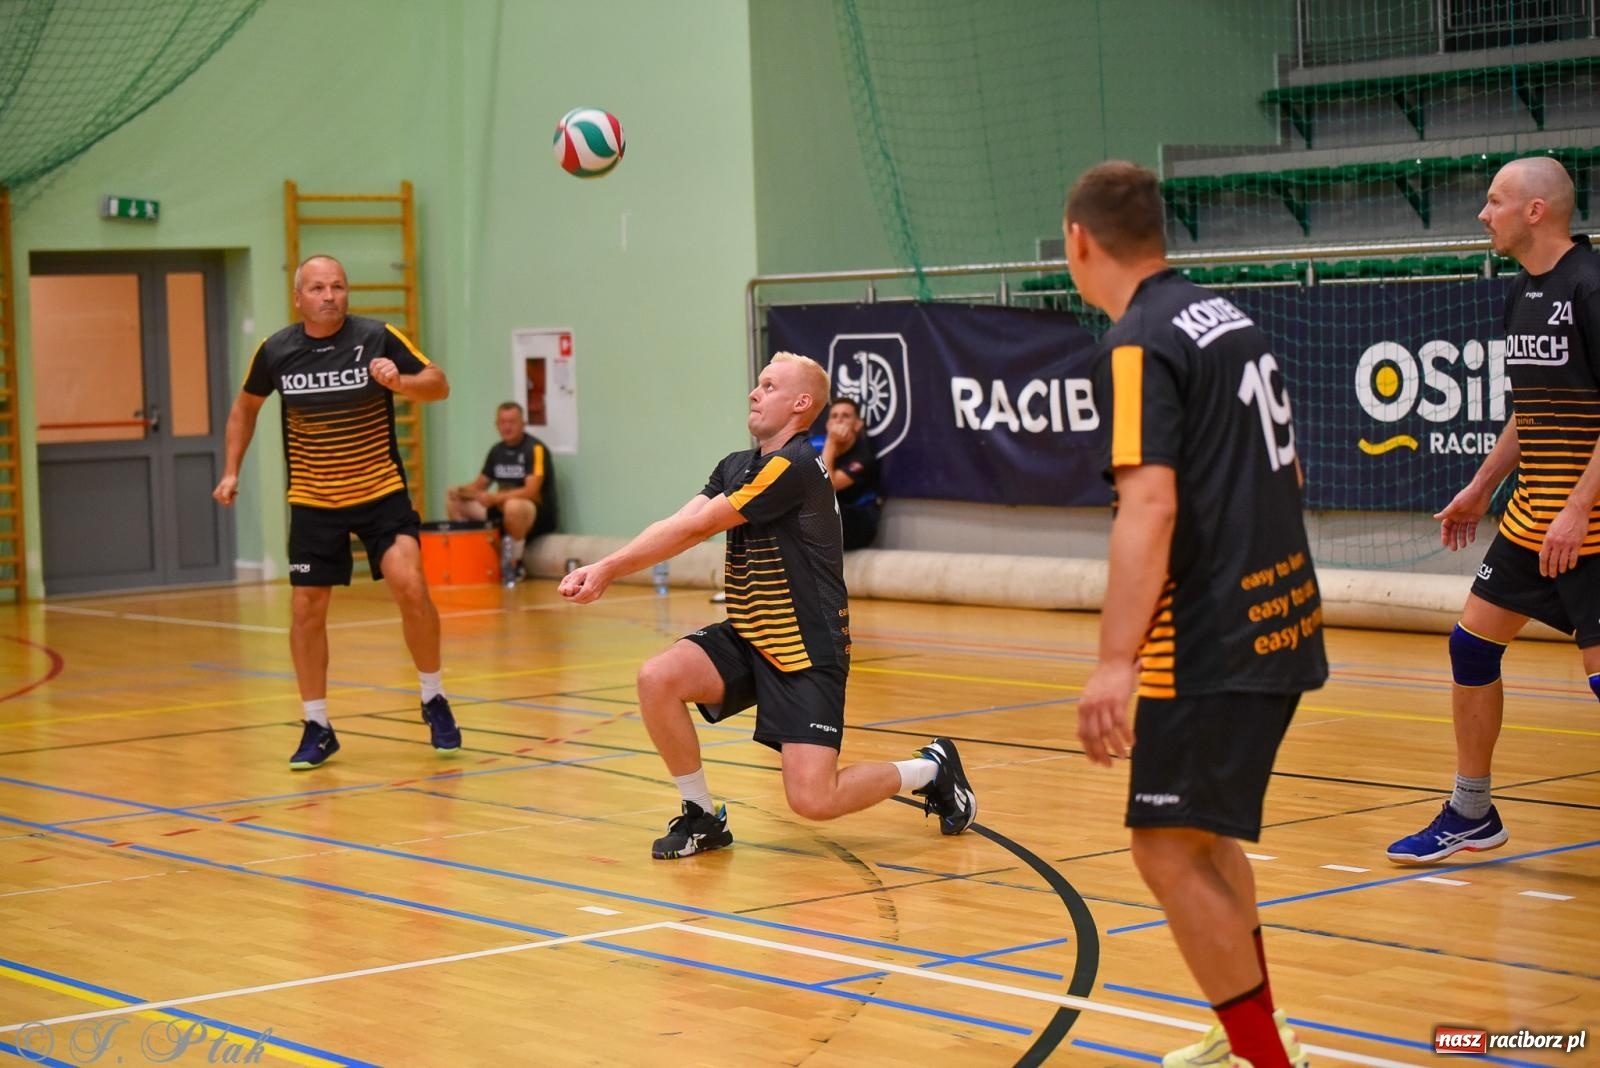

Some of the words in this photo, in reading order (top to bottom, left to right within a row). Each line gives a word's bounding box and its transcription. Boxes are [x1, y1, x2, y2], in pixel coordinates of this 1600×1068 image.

[1172, 296, 1248, 341] KOLTE
[1547, 301, 1573, 325] 24
[353, 345, 364, 362] 7
[1504, 334, 1569, 359] OLTECH
[281, 367, 369, 391] KOLTECH
[951, 376, 1100, 433] RACIB
[1238, 353, 1296, 472] 19
[1430, 432, 1497, 455] RACIB
[1241, 567, 1274, 591] easy
[1248, 595, 1289, 622] easy
[1254, 624, 1299, 655] easy
[810, 723, 837, 732] regio
